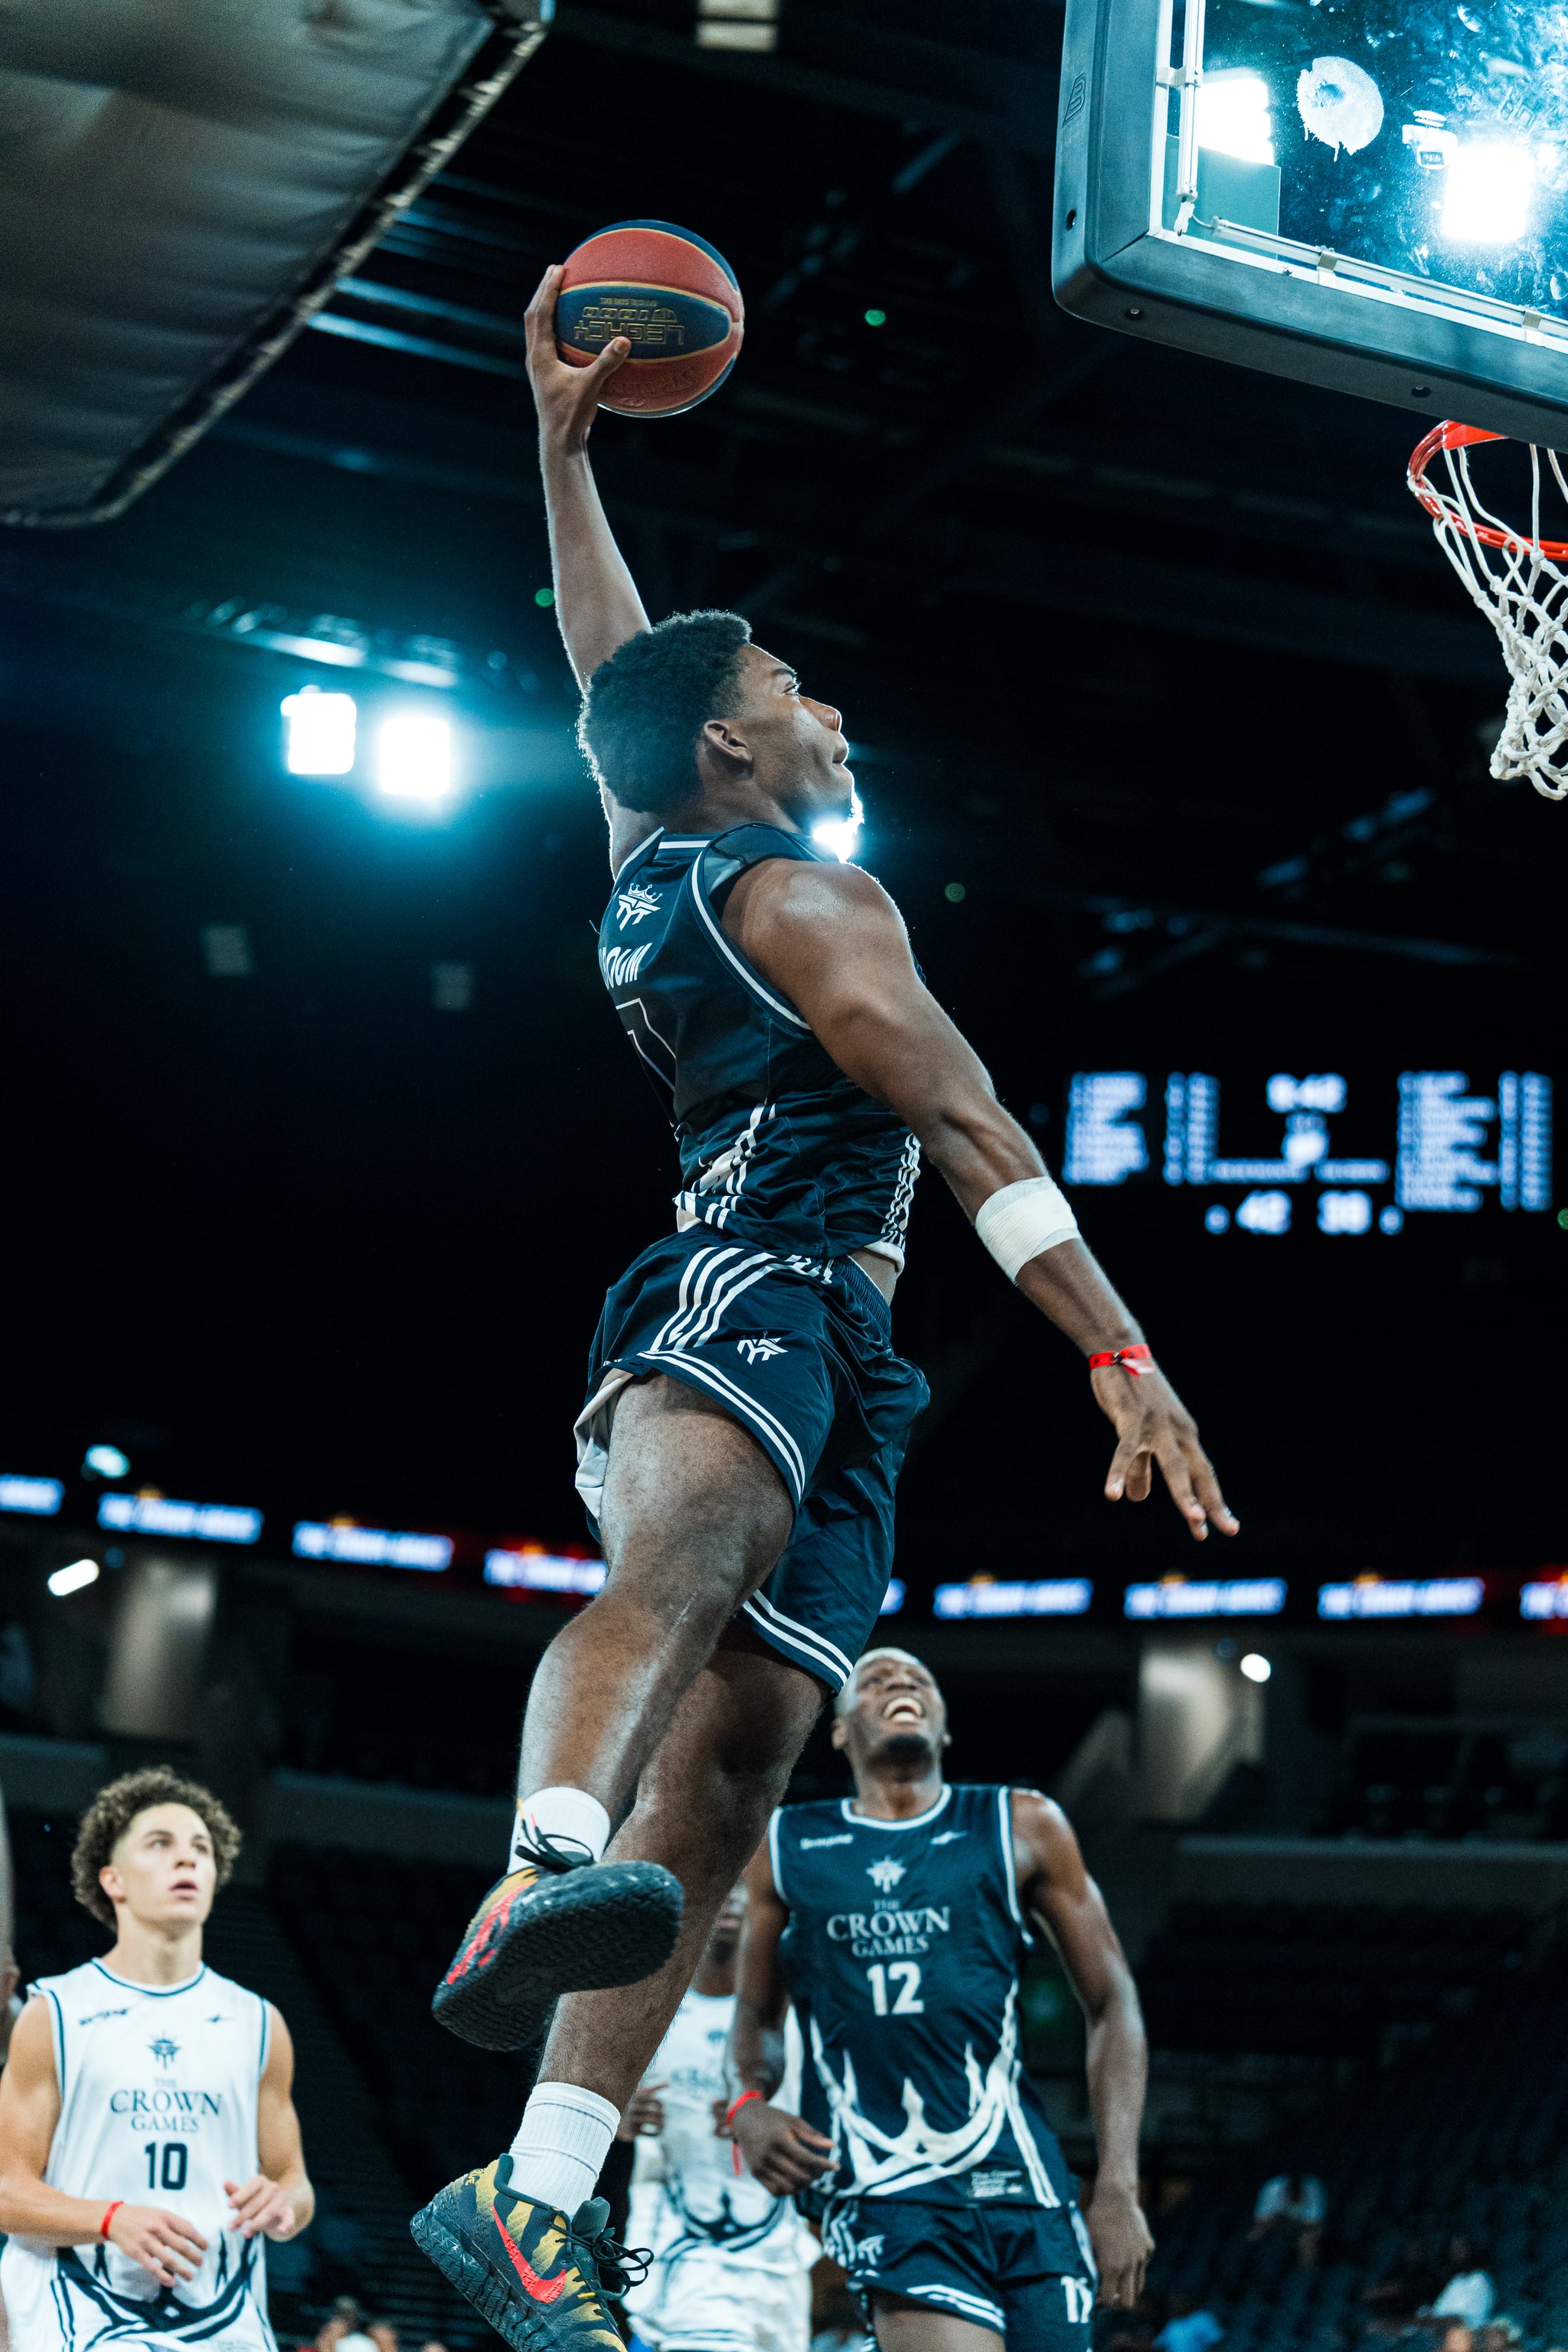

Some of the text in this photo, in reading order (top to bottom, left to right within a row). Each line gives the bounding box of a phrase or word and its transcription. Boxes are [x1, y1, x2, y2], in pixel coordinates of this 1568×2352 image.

[573, 320, 684, 345] LEGACY
[826, 1906, 951, 1942] CROWN
[851, 1935, 929, 1958] GAMES
[866, 1961, 925, 2017] 12
[154, 2077, 178, 2089] THE
[109, 2089, 222, 2116] CROWN
[131, 2115, 200, 2133] GAMES
[144, 2141, 188, 2190] 10
